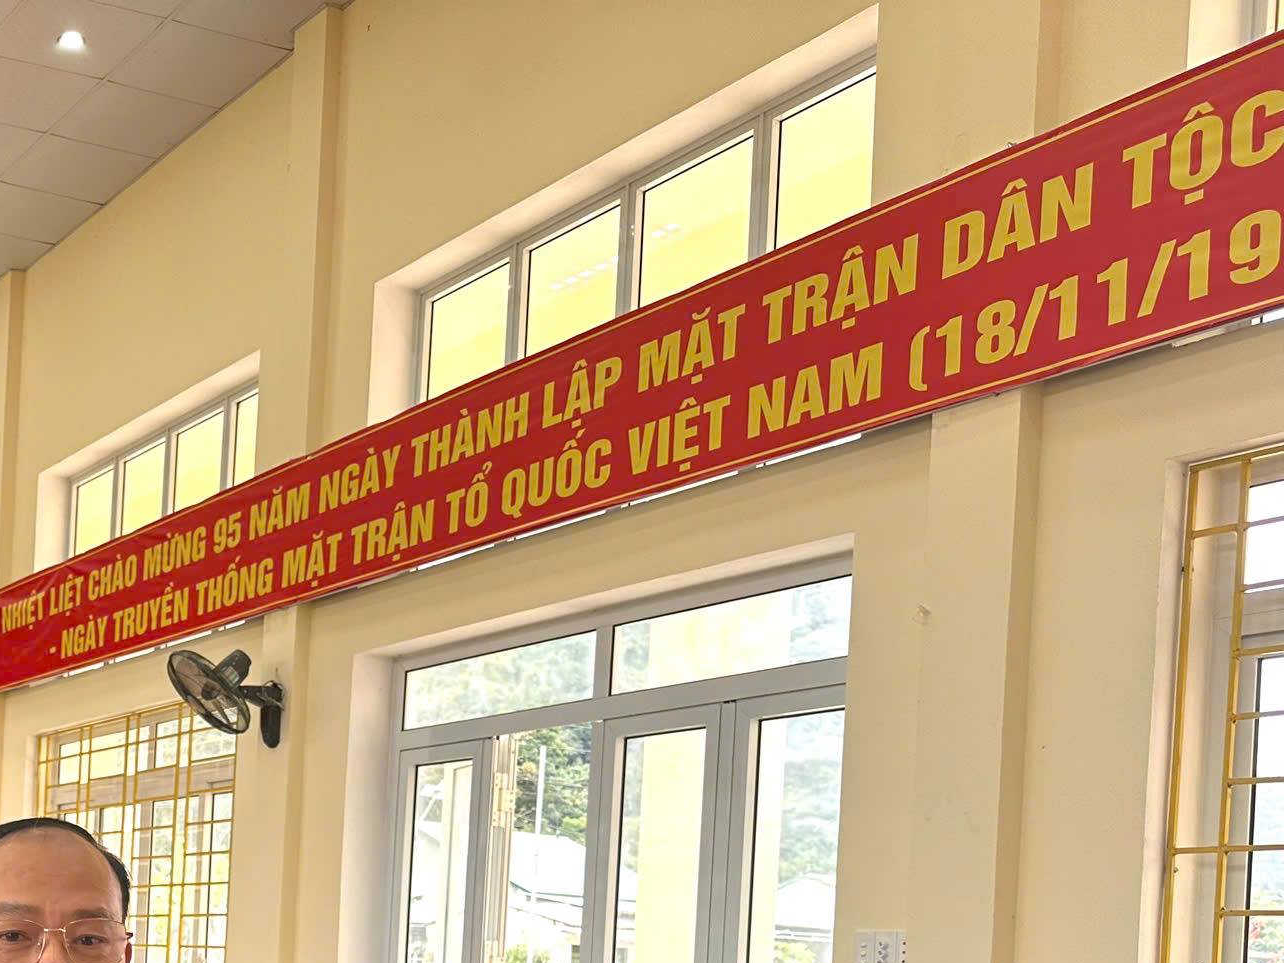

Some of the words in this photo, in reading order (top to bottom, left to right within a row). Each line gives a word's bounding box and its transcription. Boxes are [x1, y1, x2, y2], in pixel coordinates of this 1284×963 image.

[2, 590, 46, 633] NHIỆT
[49, 576, 83, 617] LIỆT
[88, 554, 137, 598] CHÀO
[144, 526, 206, 577] MỪNG
[213, 512, 242, 554] 95
[249, 482, 311, 540] NĂM
[318, 445, 401, 511] NGÀY
[411, 392, 529, 477] THÀNH
[541, 356, 623, 430] LẬP
[636, 304, 746, 393] MẶT
[762, 233, 919, 344] TRẬN
[941, 162, 1095, 280] DÂN
[1122, 89, 1284, 209] TỘC
[60, 618, 106, 659] NGÀY
[113, 581, 189, 642] TRUYỀN
[196, 557, 273, 616] THỐNG
[281, 533, 343, 592] MẶT
[351, 504, 434, 565] TRẬN
[446, 460, 493, 536] TỔ
[501, 430, 613, 519] QUỐC
[628, 394, 731, 476] VIỆT
[747, 342, 884, 440] NAM
